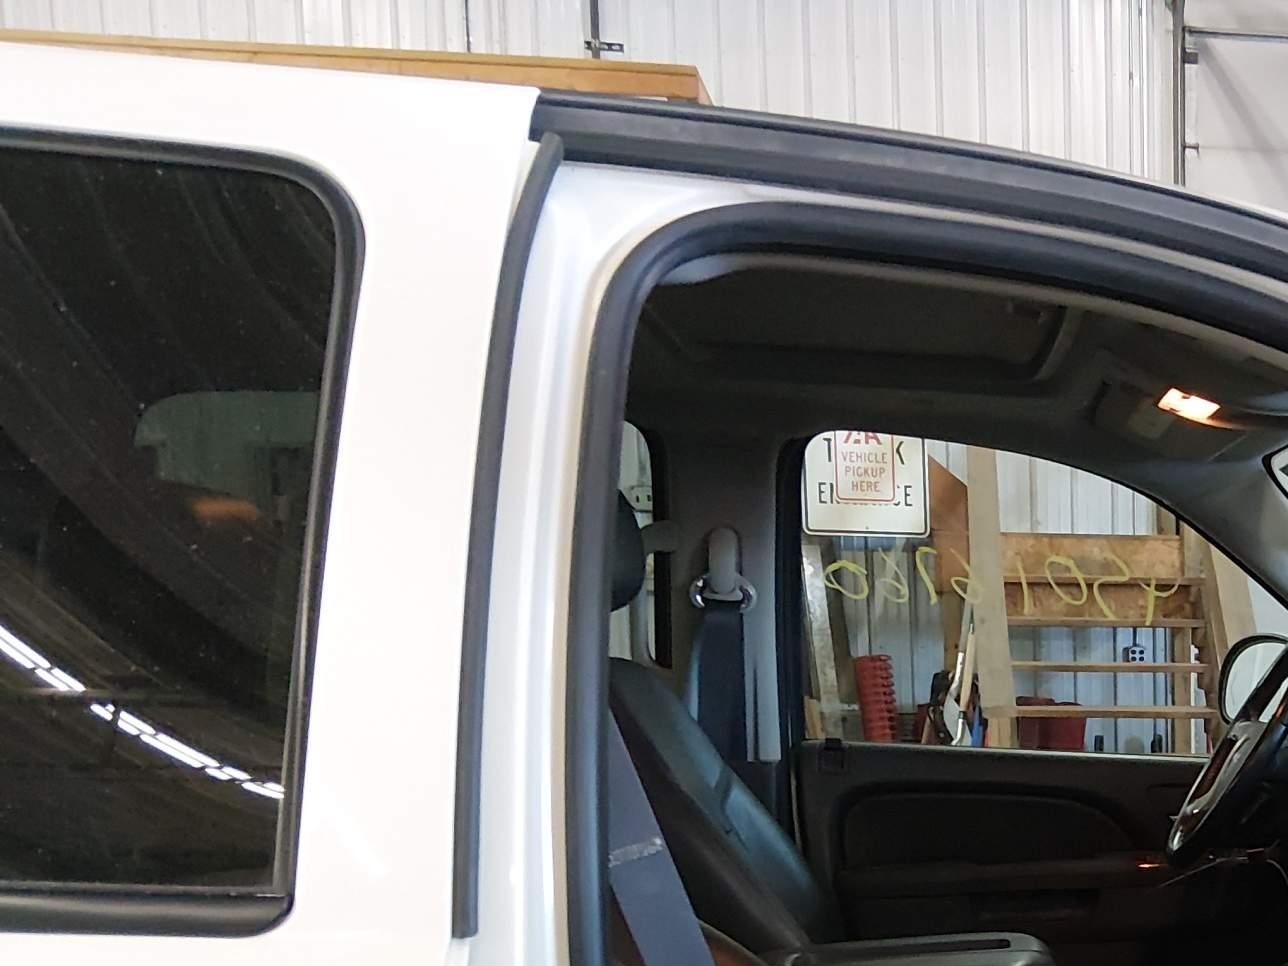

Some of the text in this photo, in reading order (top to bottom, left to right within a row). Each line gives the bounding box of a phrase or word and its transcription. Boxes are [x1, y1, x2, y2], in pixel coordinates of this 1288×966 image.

[841, 451, 888, 464] VEHICLE
[844, 465, 886, 479] PICKUP
[851, 480, 881, 493] HERE
